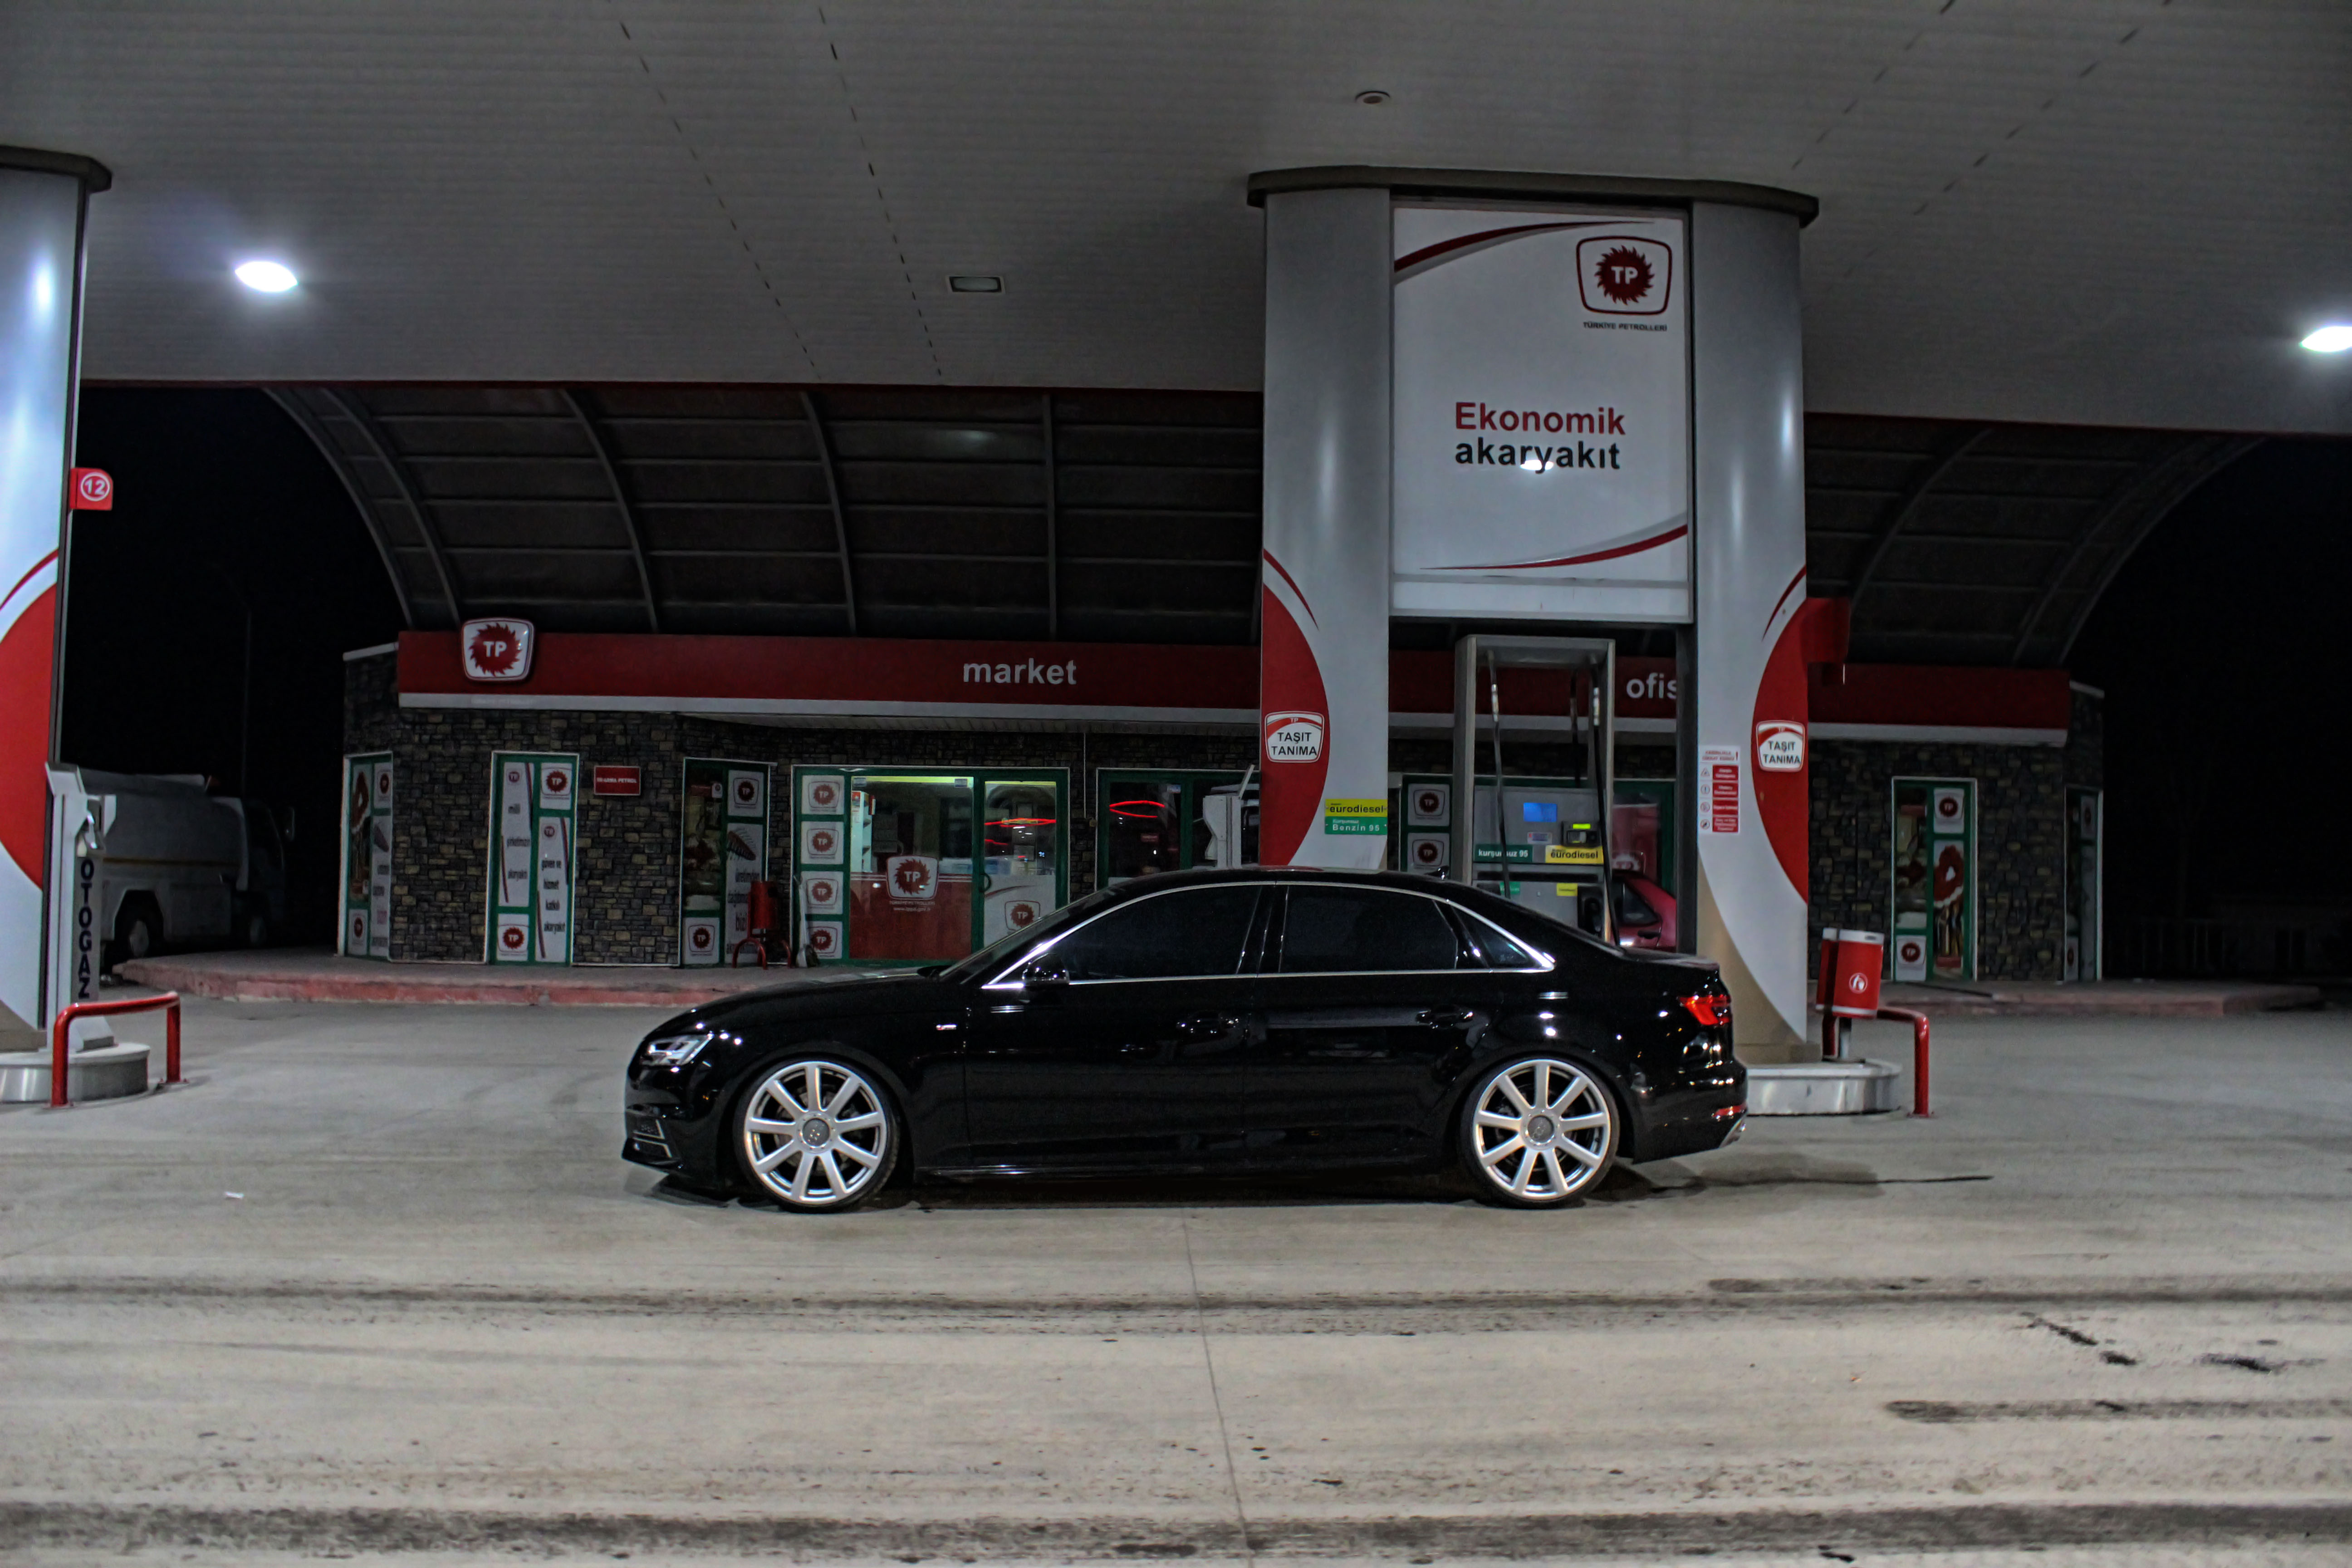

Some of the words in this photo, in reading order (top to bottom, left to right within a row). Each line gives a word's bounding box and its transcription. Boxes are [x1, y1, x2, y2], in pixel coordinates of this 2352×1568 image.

[1611, 265, 1638, 285] TP
[1583, 321, 1616, 329] TÜRKİYE
[1618, 323, 1667, 332] PETROLLERİ
[1455, 402, 1626, 436] Ekonomik
[1455, 437, 1620, 473] akaryakıt
[85, 479, 105, 495] 12
[483, 641, 507, 657] TP
[964, 658, 1077, 685] market
[1626, 672, 1676, 699] ofis
[1277, 732, 1312, 744] TAŞIT
[1271, 745, 1317, 755] TANIMA
[1768, 740, 1796, 752] TAŞIT
[1763, 754, 1801, 764] TANIMA
[551, 777, 563, 785] TP
[818, 791, 829, 799] TP
[1329, 804, 1383, 813] eurodiesel
[1519, 849, 1529, 858] 95
[1550, 850, 1598, 858] eurodiesel
[904, 871, 921, 882] TP
[1017, 911, 1029, 920] TP
[78, 858, 94, 999] OTOGAZ
